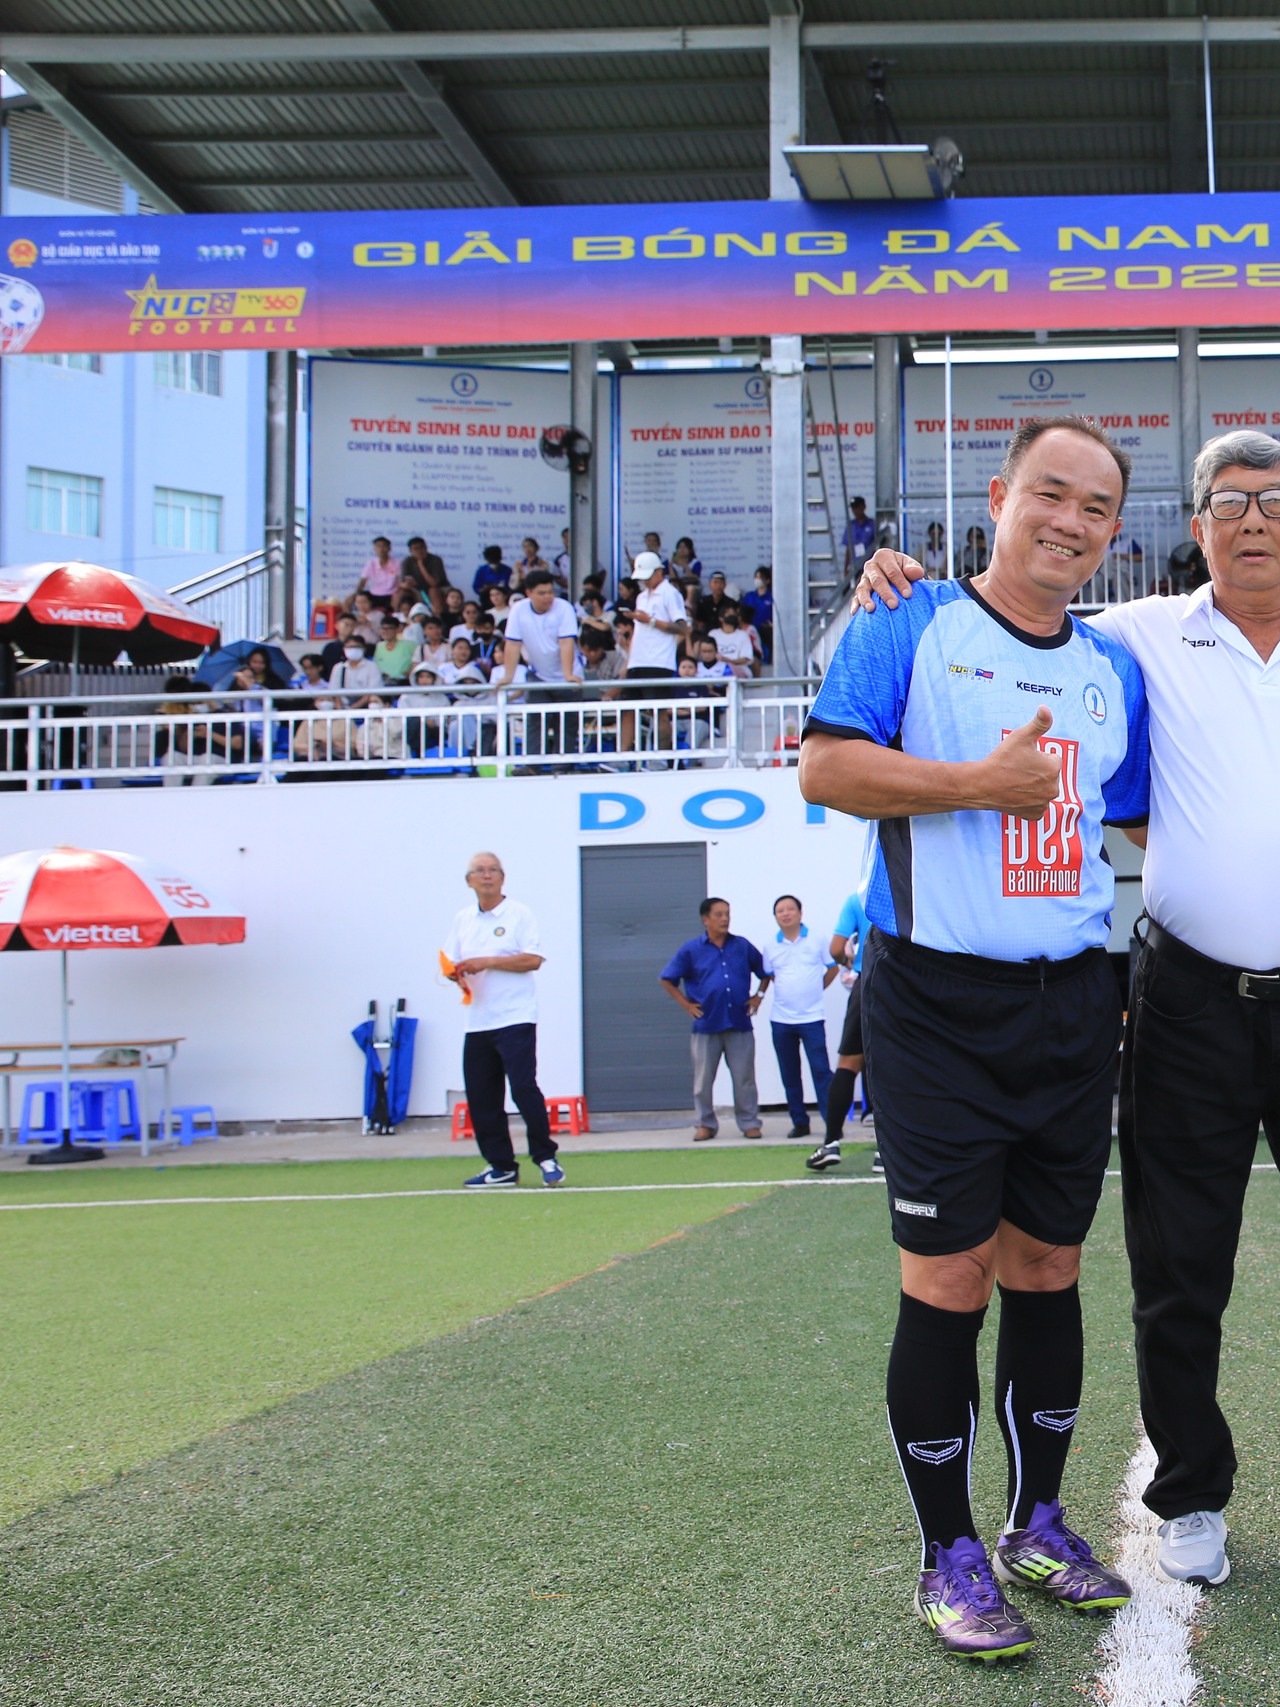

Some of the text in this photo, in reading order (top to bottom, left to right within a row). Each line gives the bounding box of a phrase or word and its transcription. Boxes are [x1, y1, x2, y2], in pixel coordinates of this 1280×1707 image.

[355, 231, 531, 265] GIẢI
[574, 227, 847, 259] BÓNG
[882, 221, 1019, 253] ĐÁ
[1060, 223, 1269, 251] NAM
[795, 264, 1009, 296] NĂM
[129, 319, 297, 336] FOOTBALL
[975, 417, 1014, 432] SINH
[1101, 412, 1133, 429] VỪA
[1138, 414, 1170, 430] HỌC
[1212, 406, 1267, 426] TUYỂN
[350, 414, 411, 433] TUYỂN
[418, 421, 460, 436] SINH
[467, 423, 501, 438] SAU
[507, 425, 536, 442] ĐẠI
[630, 421, 682, 442] TUYỂN
[687, 426, 725, 440] SINH
[730, 424, 761, 439] ĐÀO
[854, 422, 874, 438] QU
[347, 440, 392, 452] CHUYÊN
[396, 441, 433, 454] NGÀNH
[437, 443, 460, 456] ĐÀO
[463, 444, 484, 457] TẠO
[487, 444, 519, 457] TRÌNH
[522, 445, 537, 459] ĐỘ
[657, 446, 677, 457] CÁC
[681, 444, 714, 457] NGÀNH
[734, 444, 763, 457] PHẠM
[967, 438, 1001, 450] NGÀNH
[1120, 436, 1142, 447] HỌC
[345, 497, 567, 515] CHUYÊN NGÀNH ĐÀO TẠO TRÌNH ĐỘ THẠC
[688, 505, 708, 516] CÁC
[712, 504, 745, 516] NGÀNH
[47, 606, 127, 625] viettel
[1016, 680, 1063, 697] KEEPFLY
[162, 885, 211, 909] 5G
[43, 925, 143, 943] viettel
[895, 1201, 937, 1217] KEEPFLY
